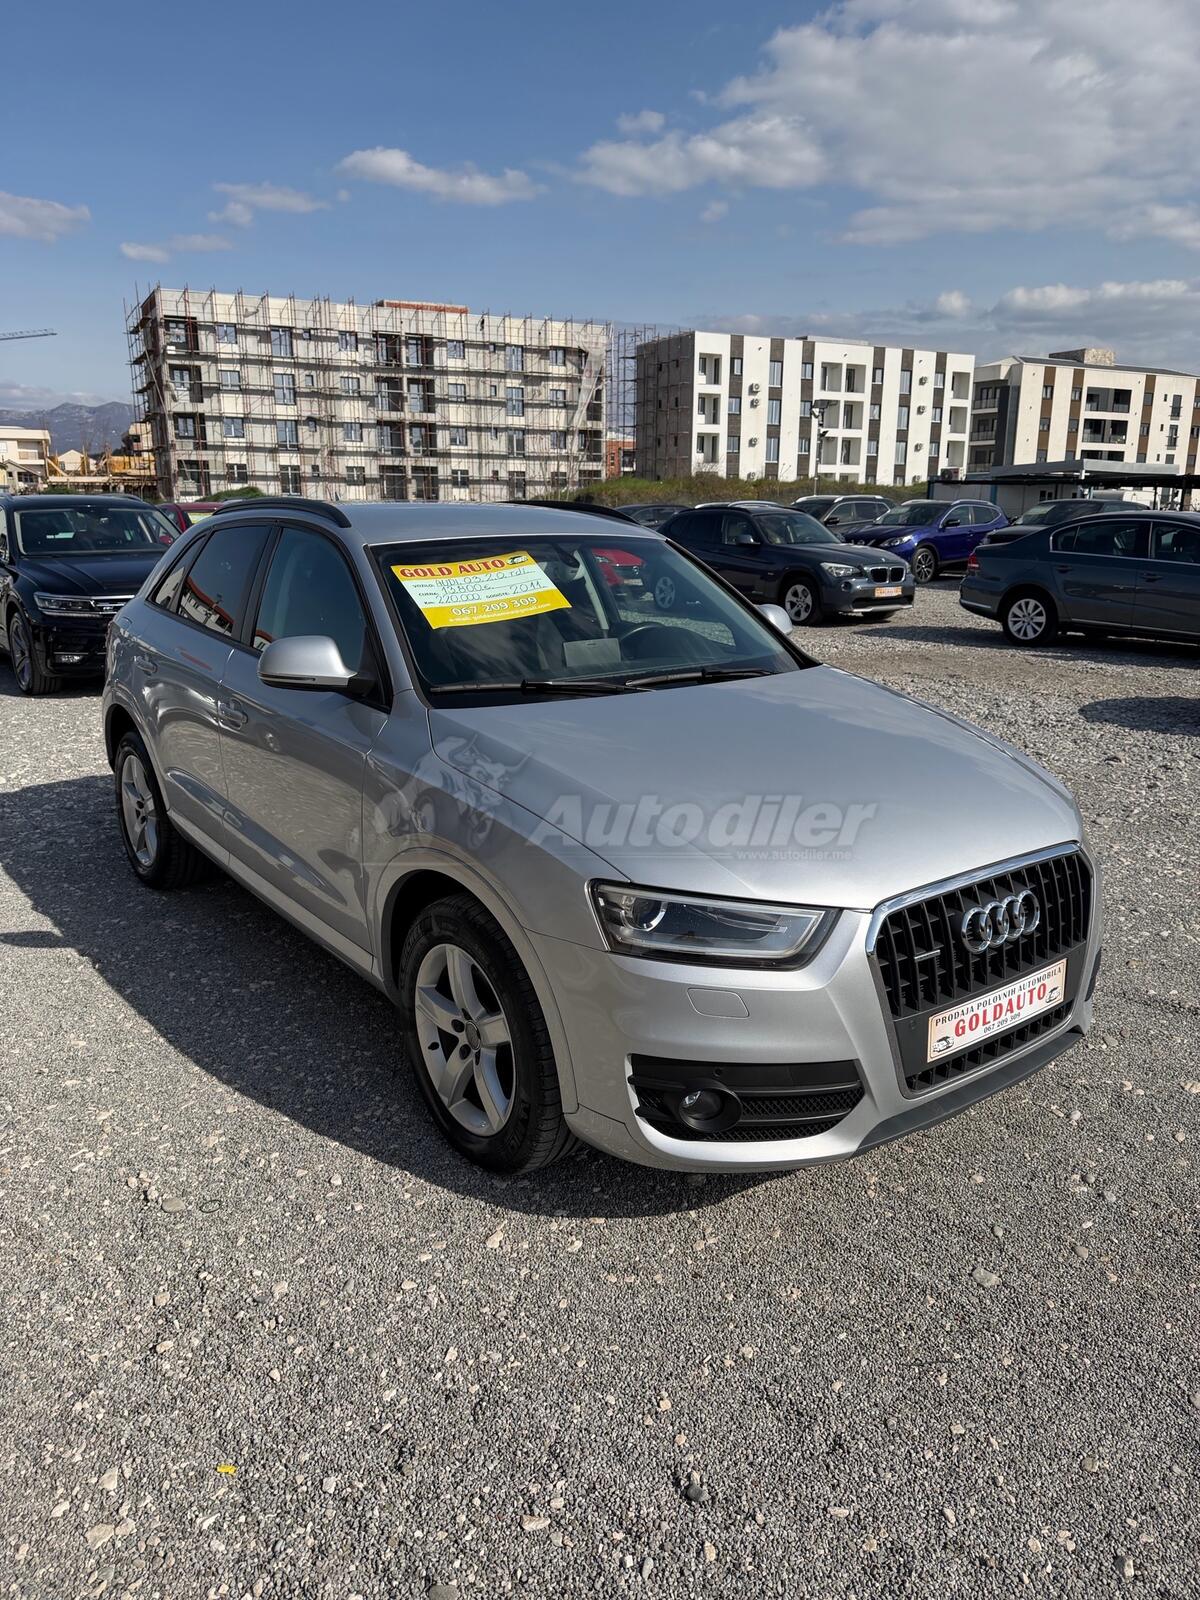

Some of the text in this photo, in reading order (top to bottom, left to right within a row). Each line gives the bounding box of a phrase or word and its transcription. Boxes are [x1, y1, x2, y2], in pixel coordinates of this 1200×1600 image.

[399, 559, 507, 578] GOLD AUTO
[451, 596, 538, 615] 067 209 309
[935, 967, 1062, 1026] PRODAJA POLOVNIH AUTOMOBILA
[954, 982, 1047, 1037] GOLDAUTO
[983, 1012, 1021, 1034] 067 209 309
